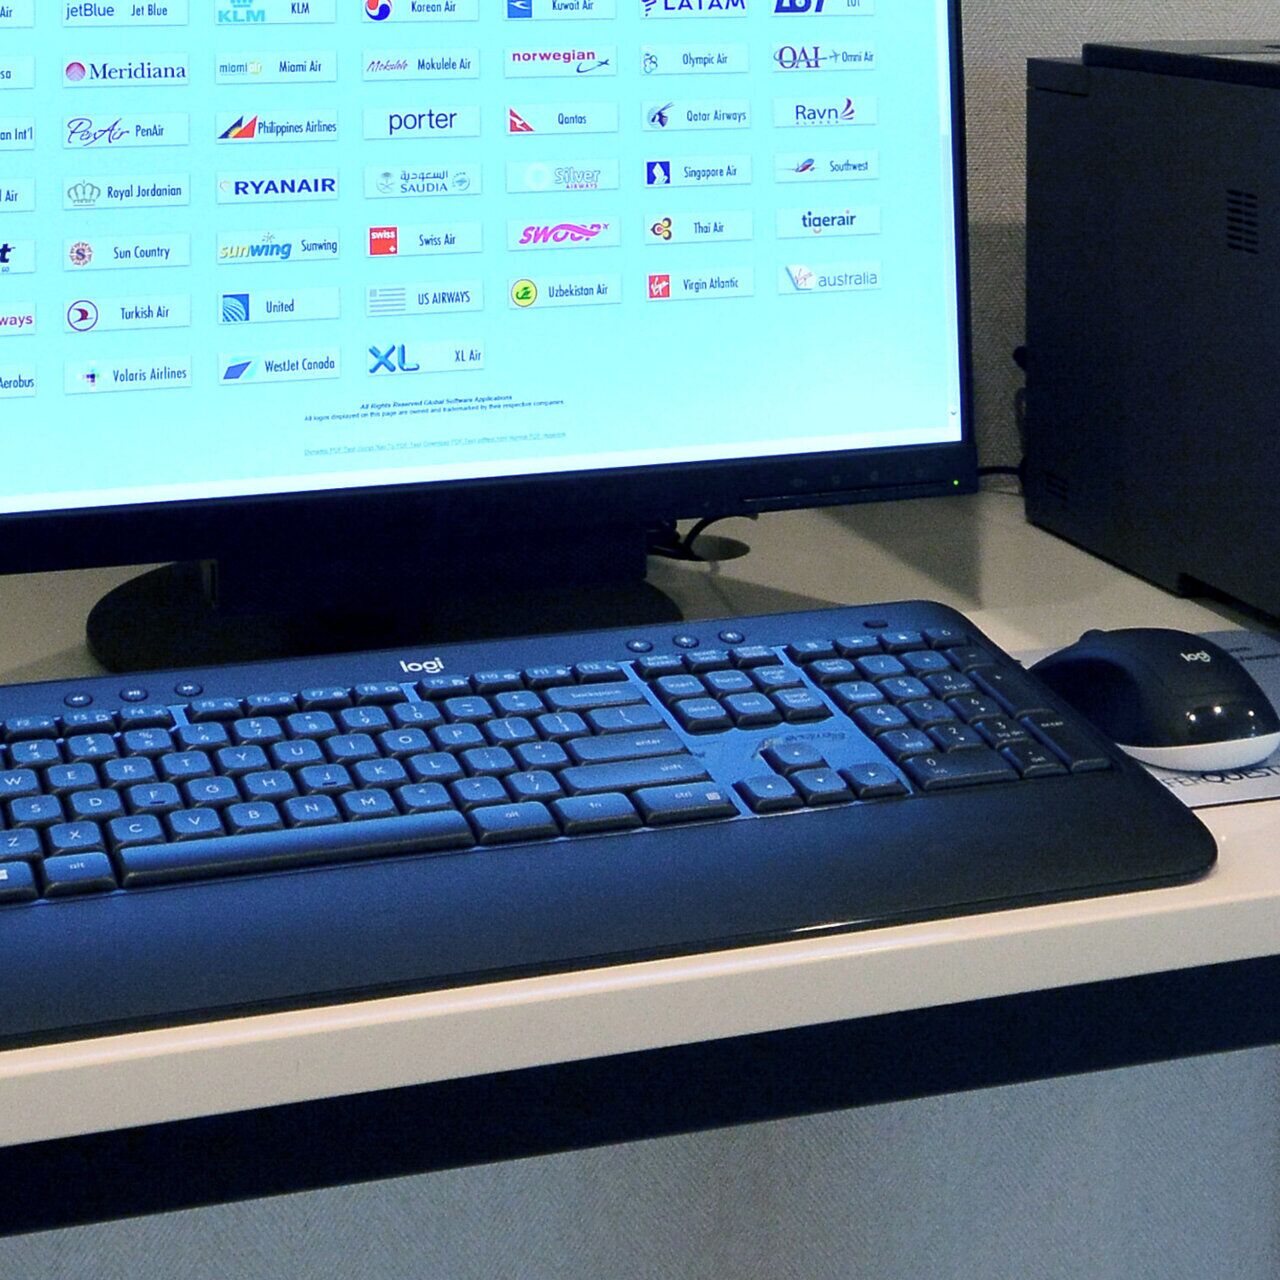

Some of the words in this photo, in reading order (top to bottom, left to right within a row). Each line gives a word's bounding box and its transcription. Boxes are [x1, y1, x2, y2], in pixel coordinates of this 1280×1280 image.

[0, 6, 13, 18] Air
[66, 3, 115, 20] jetBlue
[131, 5, 145, 16] Jet
[148, 4, 167, 16] Blue
[291, 2, 309, 14] KLM
[411, 1, 441, 13] Korean
[445, 1, 456, 12] Air
[552, 0, 580, 11] Kuwait
[583, 0, 594, 10] Air
[219, 10, 265, 22] KLM
[512, 50, 595, 62] norwegian
[682, 54, 714, 67] Olympic
[717, 54, 728, 64] Air
[778, 45, 820, 68] OAI
[842, 51, 862, 62] Omni
[864, 52, 874, 61] Air
[90, 63, 186, 79] Meridiana
[279, 61, 307, 73] Miami
[310, 61, 322, 72] Air
[417, 59, 457, 71] Mokulele
[459, 58, 471, 69] Air
[686, 111, 711, 122] Qatar
[714, 111, 746, 122] Airways
[796, 104, 839, 120] Ravn
[389, 109, 457, 135] porter
[557, 113, 587, 125] Qantas
[136, 125, 164, 137] PenAir
[258, 121, 303, 136] Philippines
[305, 121, 336, 133] Airlines
[684, 166, 723, 180] Singapore
[726, 165, 737, 176] Air
[830, 160, 868, 172] Southwest
[554, 167, 600, 184] Silver
[107, 185, 133, 200] Royal
[136, 184, 181, 198] Jordanian
[235, 178, 335, 195] RYANAIR
[401, 182, 448, 194] SAUDIA
[5, 189, 18, 202] Air
[802, 210, 856, 231] tigerair
[371, 230, 395, 239] swiss
[694, 223, 711, 234] Thai
[714, 222, 724, 233] Air
[301, 240, 337, 253] Sunwing
[419, 234, 441, 246] Swiss
[444, 234, 456, 245] Air
[113, 247, 131, 259] Sun
[135, 246, 170, 260] Country
[220, 242, 292, 259] sunwing
[683, 279, 707, 291] Virgin
[710, 277, 738, 289] Atlantic
[819, 271, 877, 287] australia
[549, 285, 594, 297] Uzbekistan
[597, 284, 608, 295] Air
[418, 293, 429, 305] US
[432, 291, 470, 304] AIRWAYS
[120, 307, 153, 320] Turkish
[157, 305, 169, 318] Air
[266, 300, 294, 313] United
[369, 344, 419, 373] XL
[455, 350, 466, 361] XL
[469, 349, 481, 361] Air
[265, 359, 299, 372] WestJet
[302, 357, 334, 370] Canada
[113, 369, 147, 382] Volaris
[150, 367, 187, 381] Airlines
[1181, 651, 1211, 662] logi
[400, 657, 444, 673] logi
